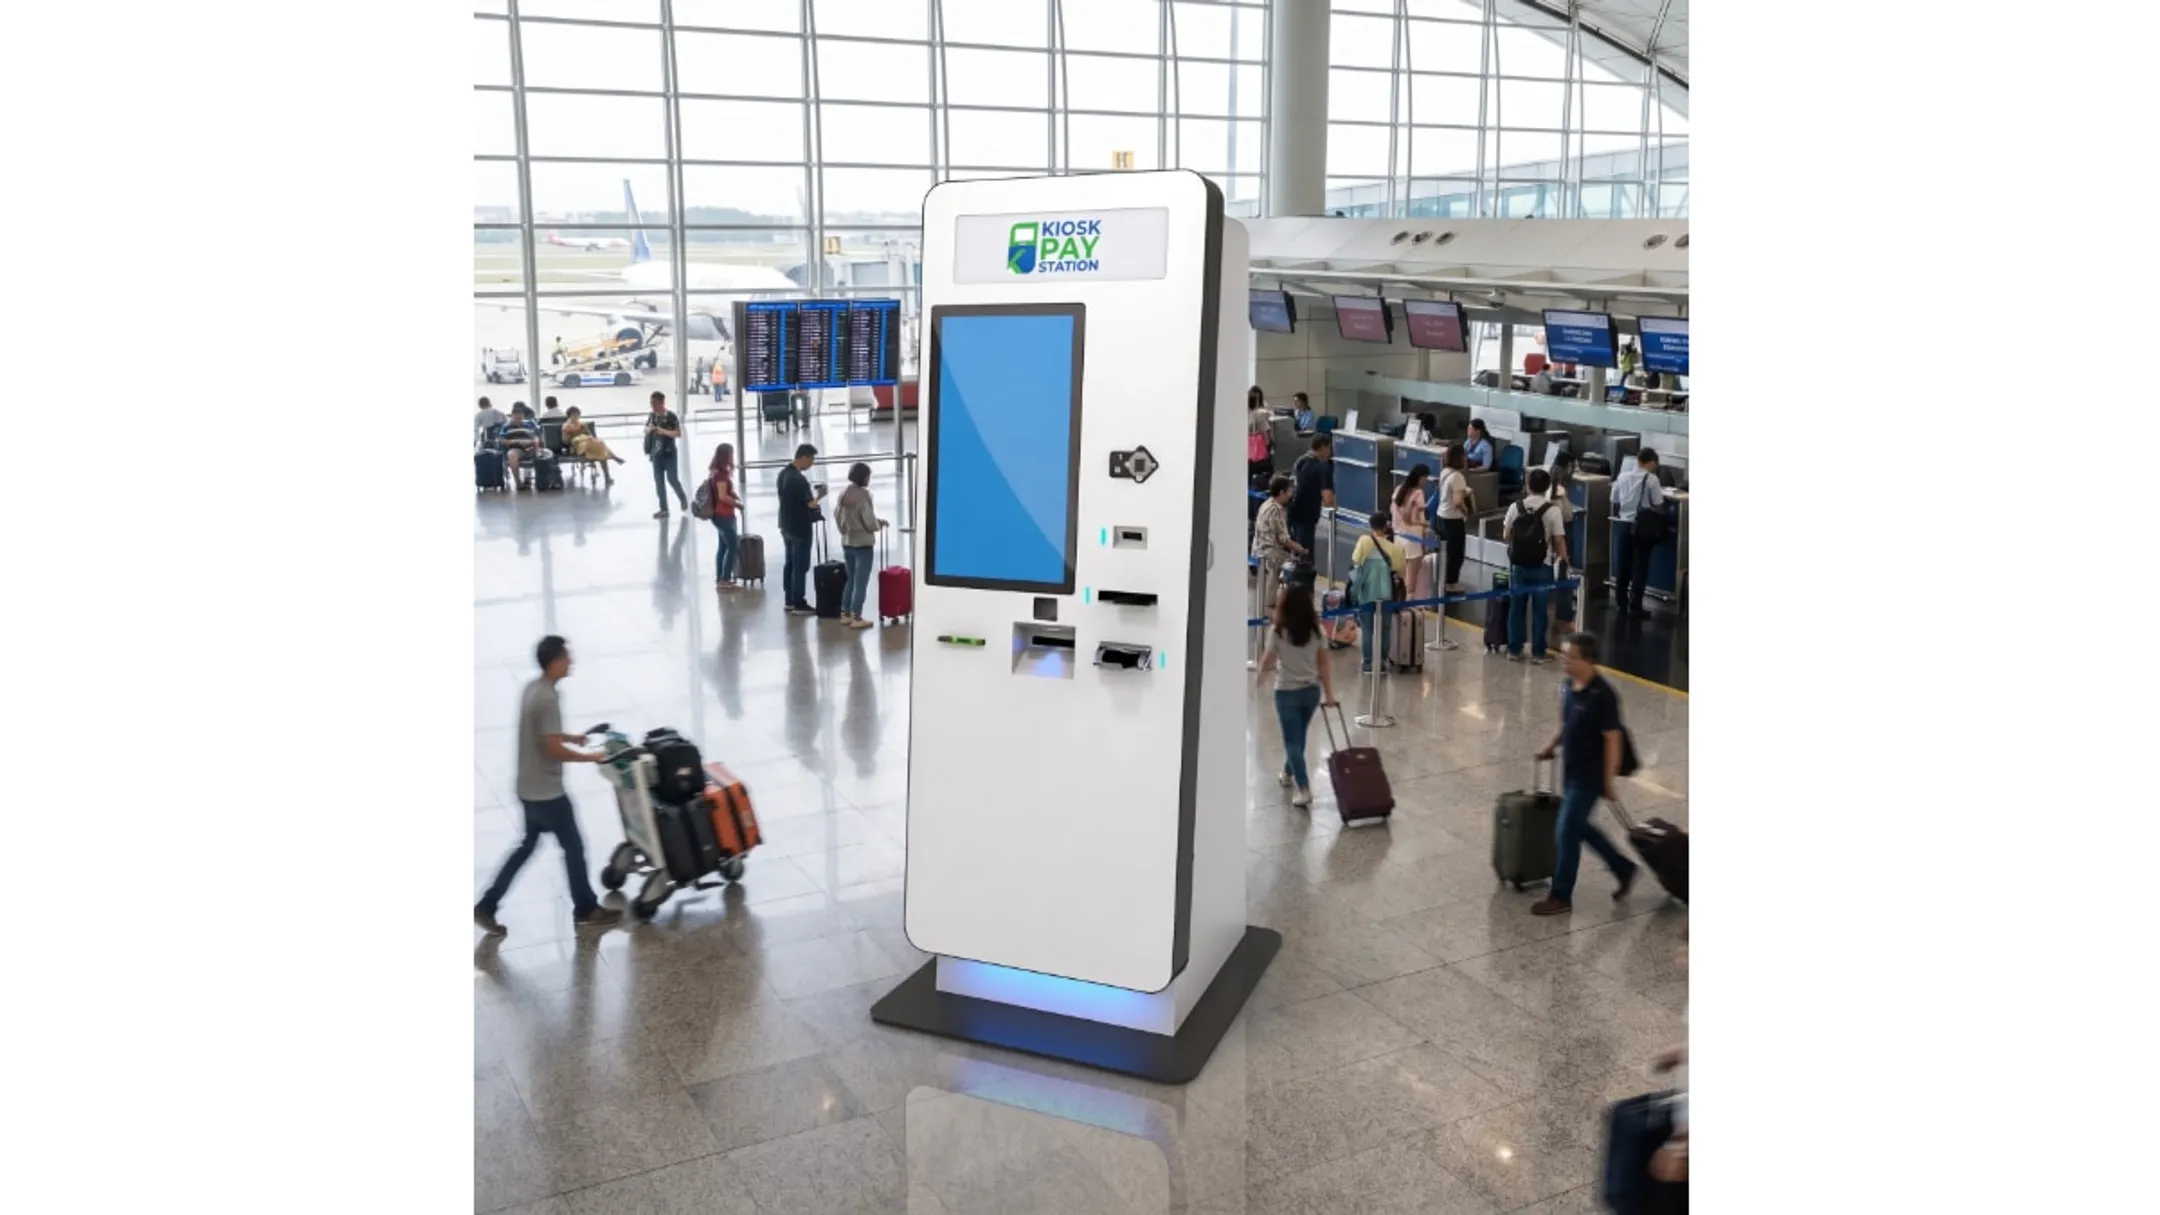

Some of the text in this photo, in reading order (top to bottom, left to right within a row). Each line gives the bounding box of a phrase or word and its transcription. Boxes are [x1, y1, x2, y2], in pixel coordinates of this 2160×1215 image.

[1042, 220, 1101, 236] KIOSK
[1041, 236, 1099, 260] PAY
[1039, 260, 1099, 272] STATION
